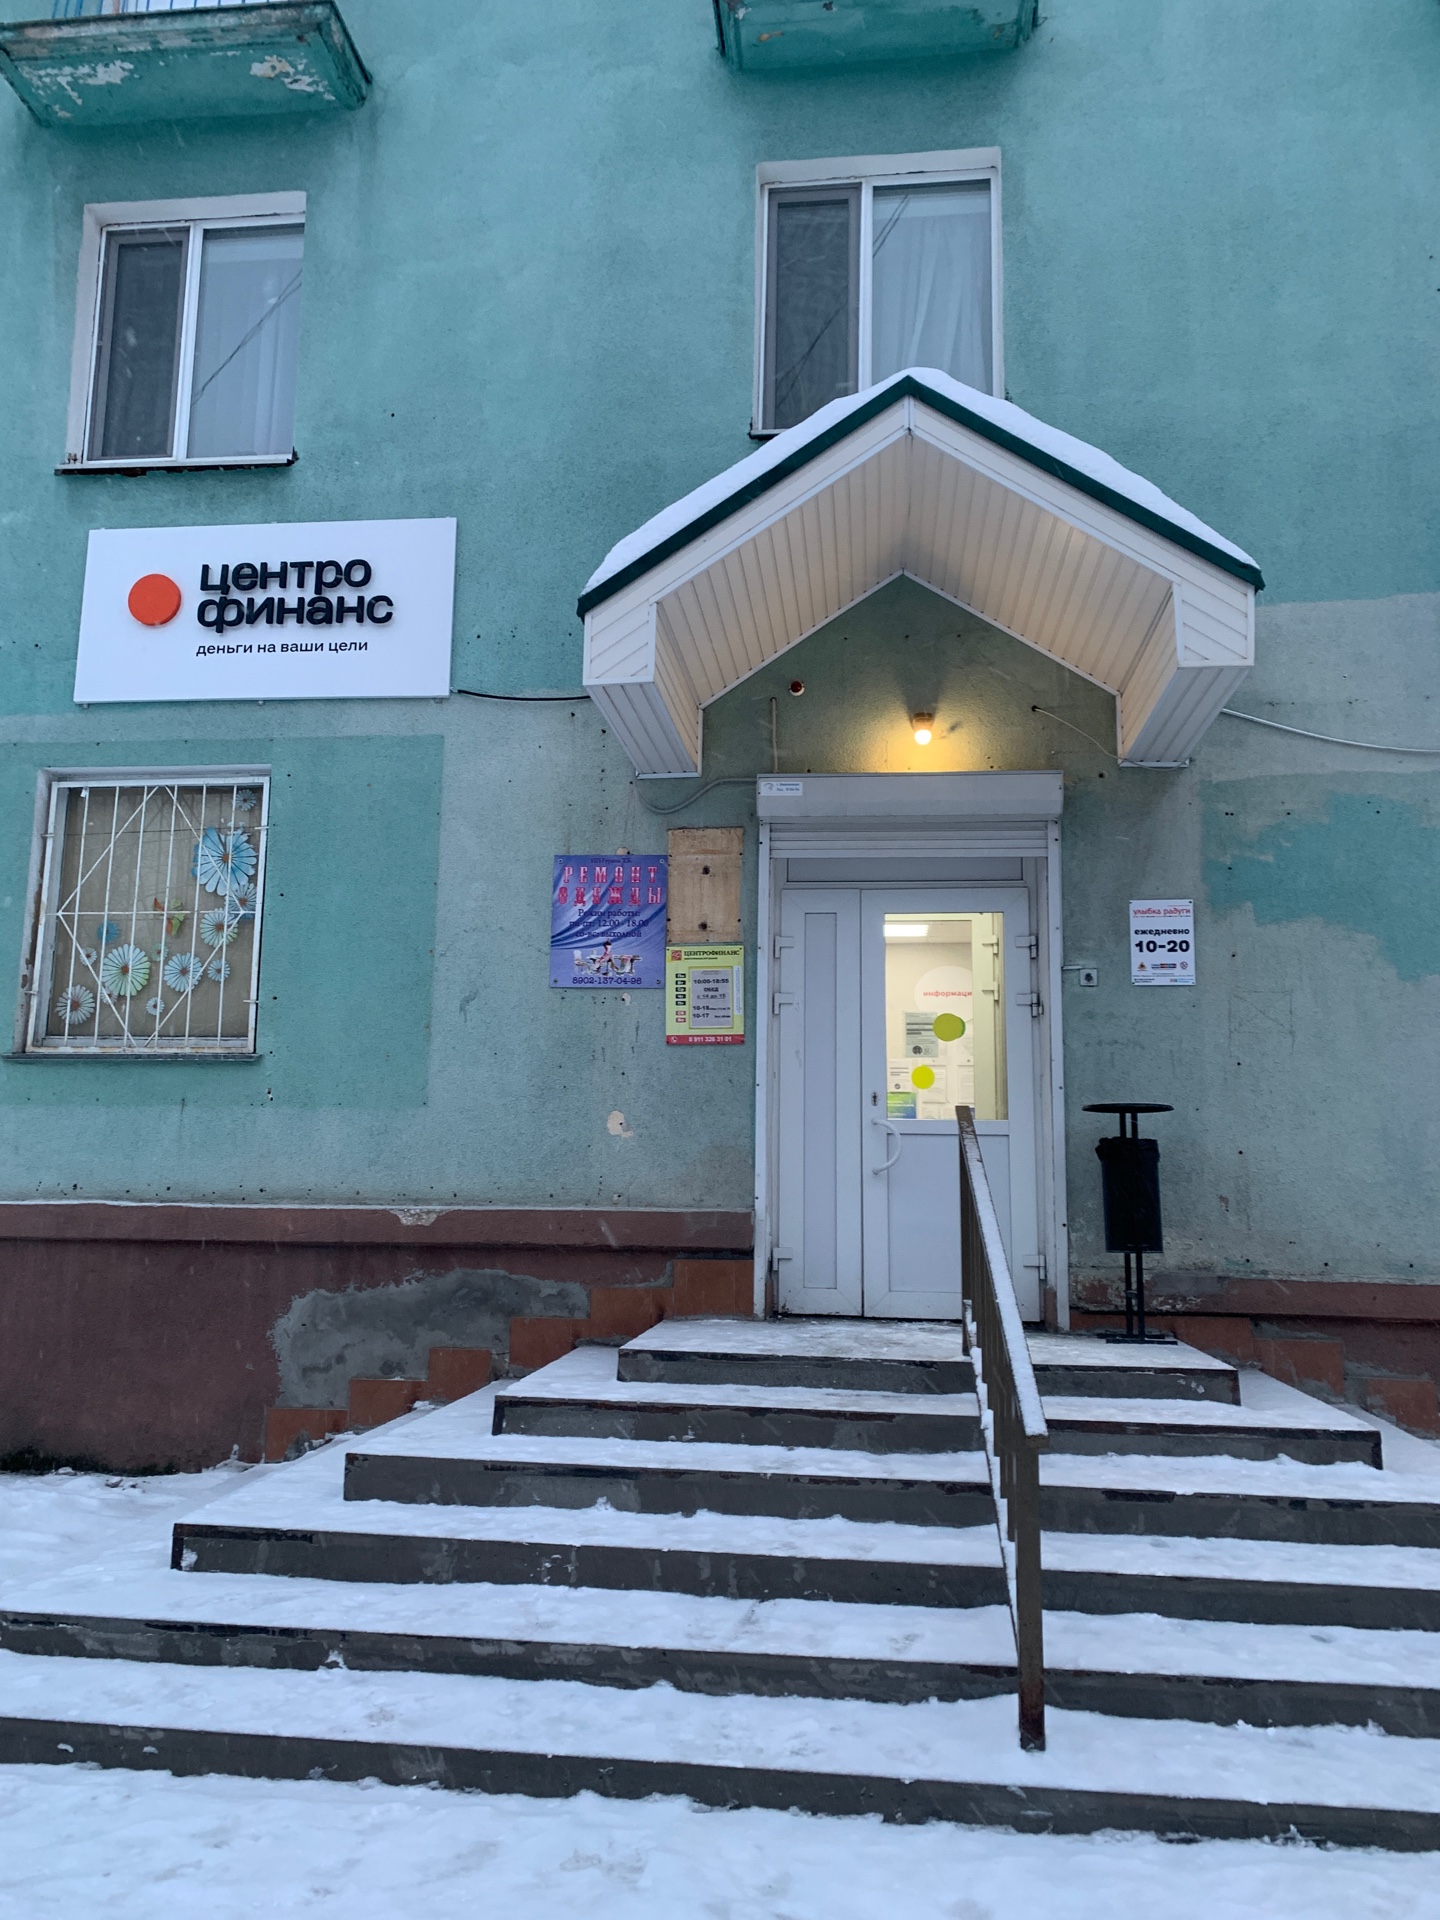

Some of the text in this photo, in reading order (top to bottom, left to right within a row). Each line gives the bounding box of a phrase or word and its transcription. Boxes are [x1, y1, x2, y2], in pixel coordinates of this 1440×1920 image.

[199, 558, 372, 596] центро
[197, 595, 394, 633] финанс
[196, 641, 368, 657] деньги на ваши цели
[563, 866, 658, 884] РЕМОНТ
[557, 886, 662, 906] ОДЕЖДЫ
[1132, 907, 1191, 916] улыбка радуги
[598, 919, 620, 927] 12.00
[627, 919, 649, 927] 18.00
[1134, 928, 1190, 936] ежедневно
[684, 949, 739, 957] ЦЕНТРОФИНАНС
[1135, 940, 1190, 953] 10-20
[923, 990, 972, 998] информаци
